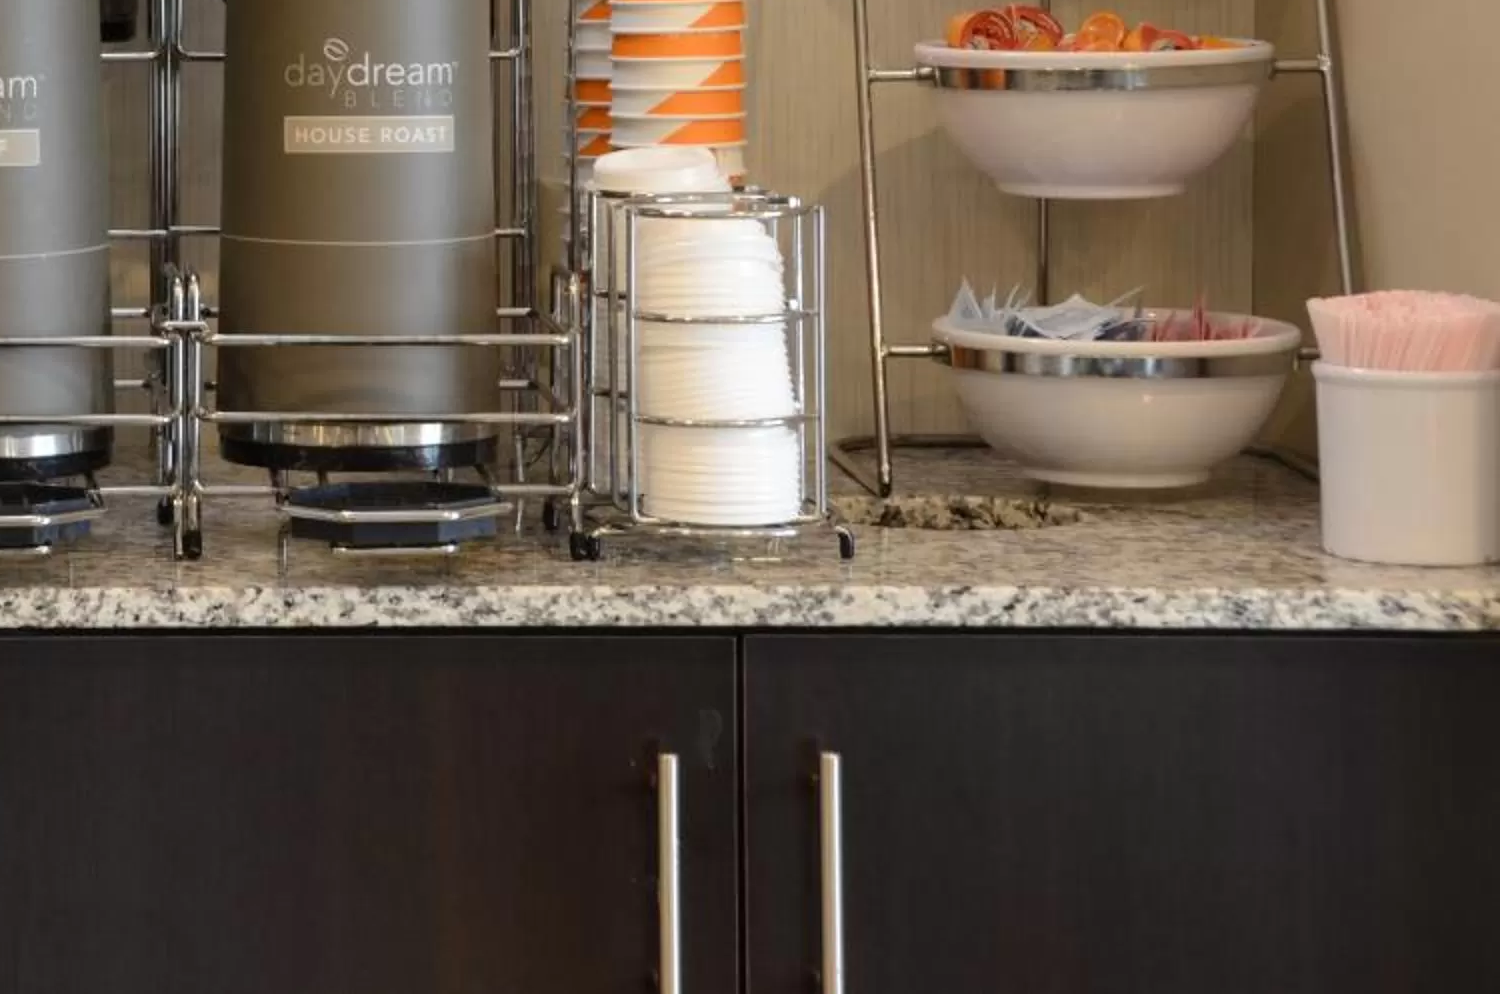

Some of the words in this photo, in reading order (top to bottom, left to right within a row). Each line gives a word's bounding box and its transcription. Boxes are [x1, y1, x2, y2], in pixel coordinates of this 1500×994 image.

[284, 52, 454, 99] daydream
[344, 89, 453, 108] BLEND
[295, 126, 371, 144] HOUSE
[380, 125, 447, 144] ROAST
